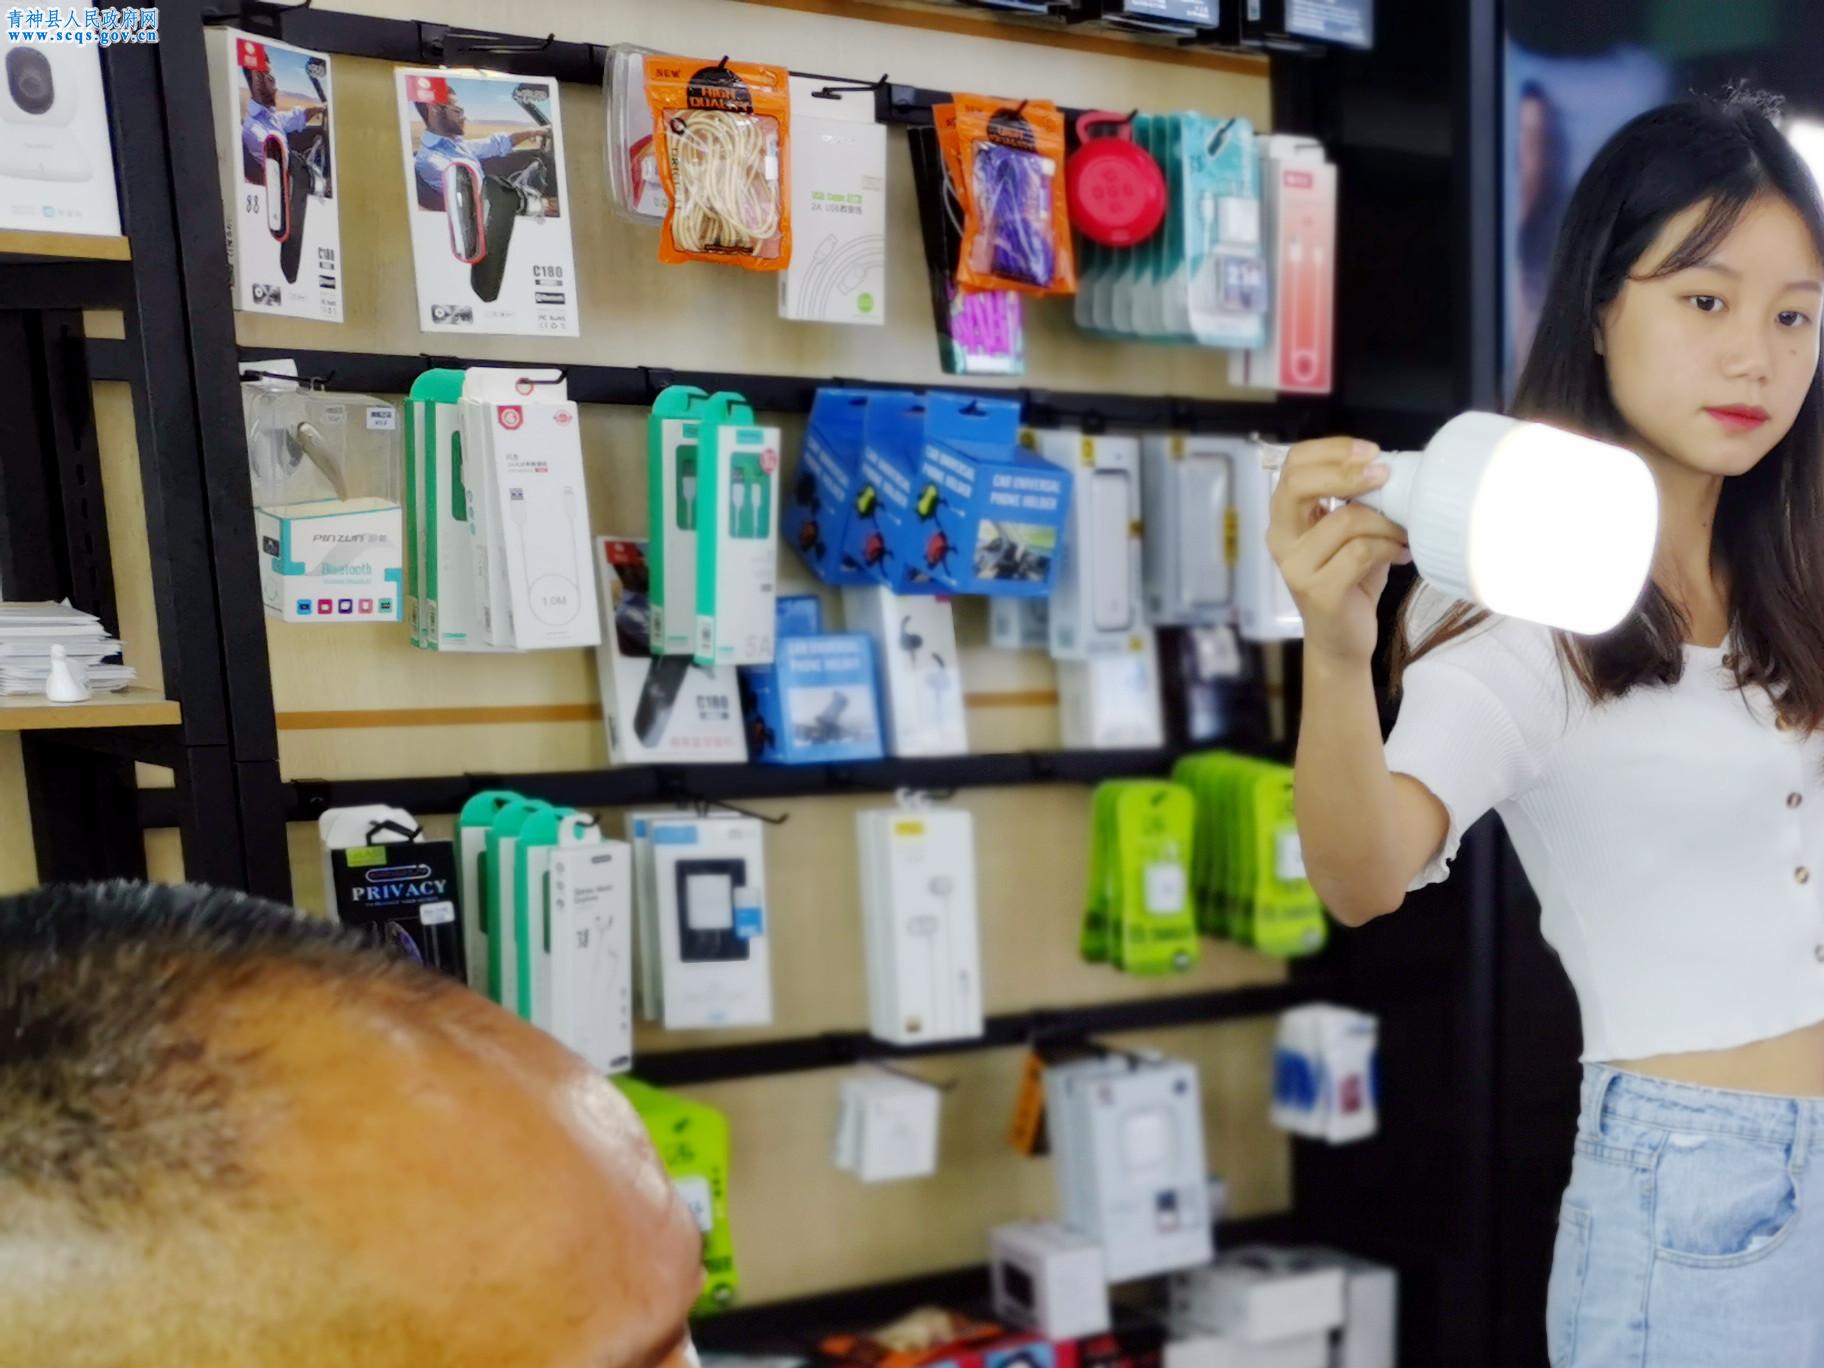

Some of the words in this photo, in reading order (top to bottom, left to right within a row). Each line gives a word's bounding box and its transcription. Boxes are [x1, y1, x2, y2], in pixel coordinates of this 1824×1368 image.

[656, 68, 681, 78] NEW
[533, 265, 564, 278] C180
[321, 561, 373, 577] Bluetooth
[351, 879, 447, 903] PRIVACY
